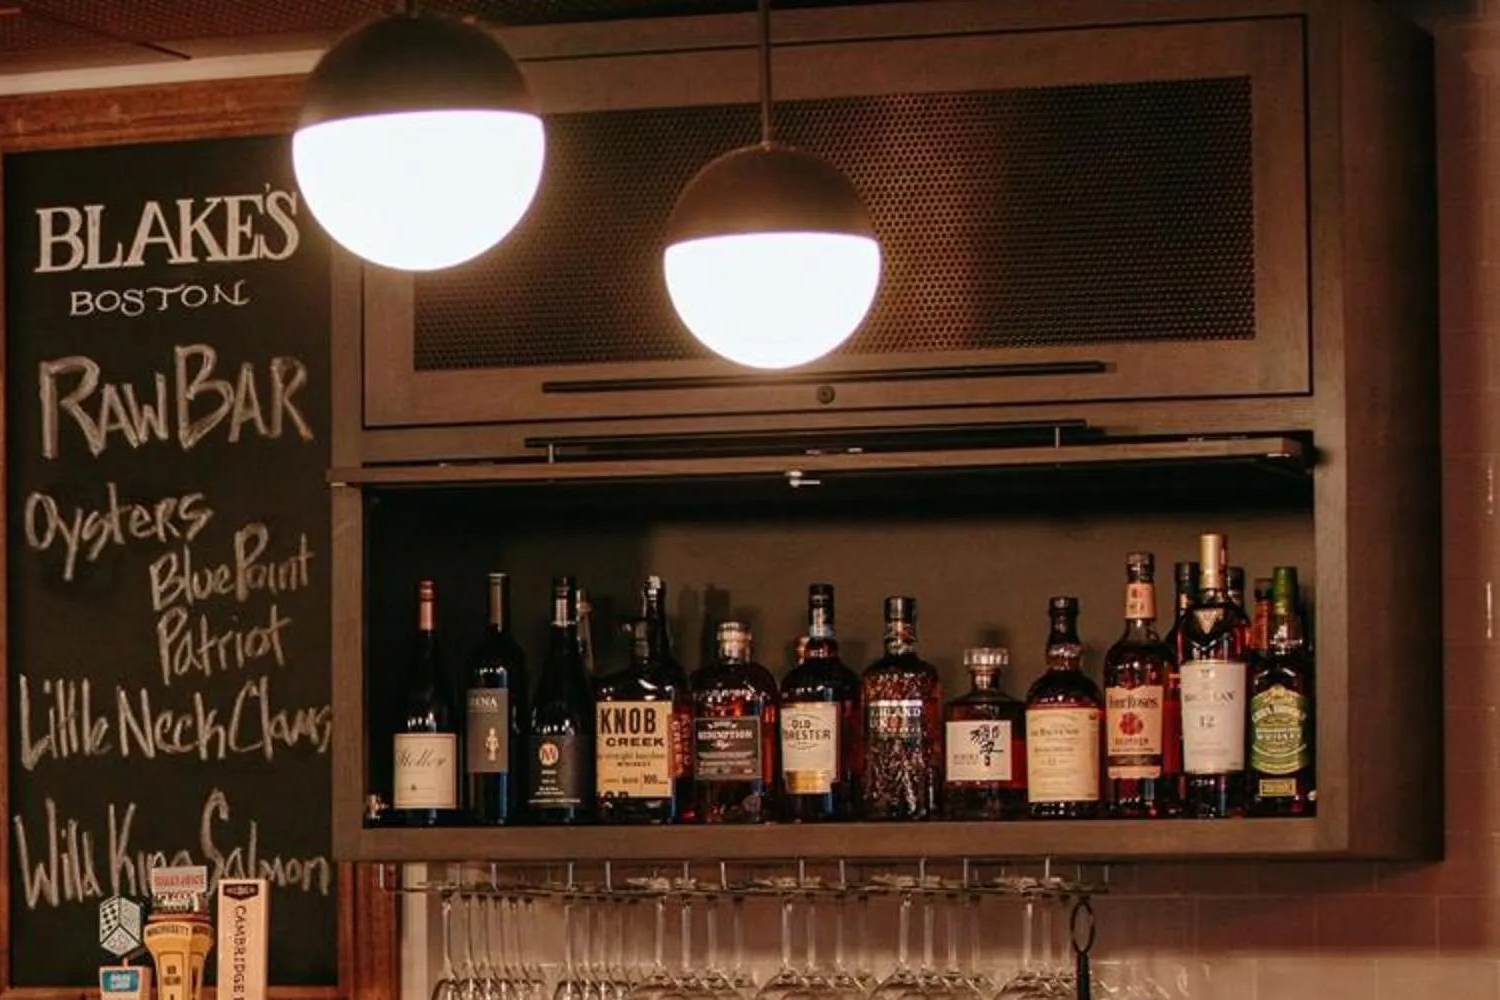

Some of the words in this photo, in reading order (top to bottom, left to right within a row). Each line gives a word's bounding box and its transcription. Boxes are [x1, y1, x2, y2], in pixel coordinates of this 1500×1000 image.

[34, 183, 300, 273] BLAKE'S
[69, 280, 252, 317] BOSTON
[157, 605, 292, 686] Patriot
[19, 674, 109, 771] Little
[117, 685, 227, 761] Neck
[601, 707, 656, 734] KNOB
[606, 737, 664, 747] CREEK
[792, 719, 812, 729] OLD
[14, 797, 102, 909] Wild
[201, 787, 332, 896] Salmon
[233, 904, 247, 993] CAMBRIDGE
